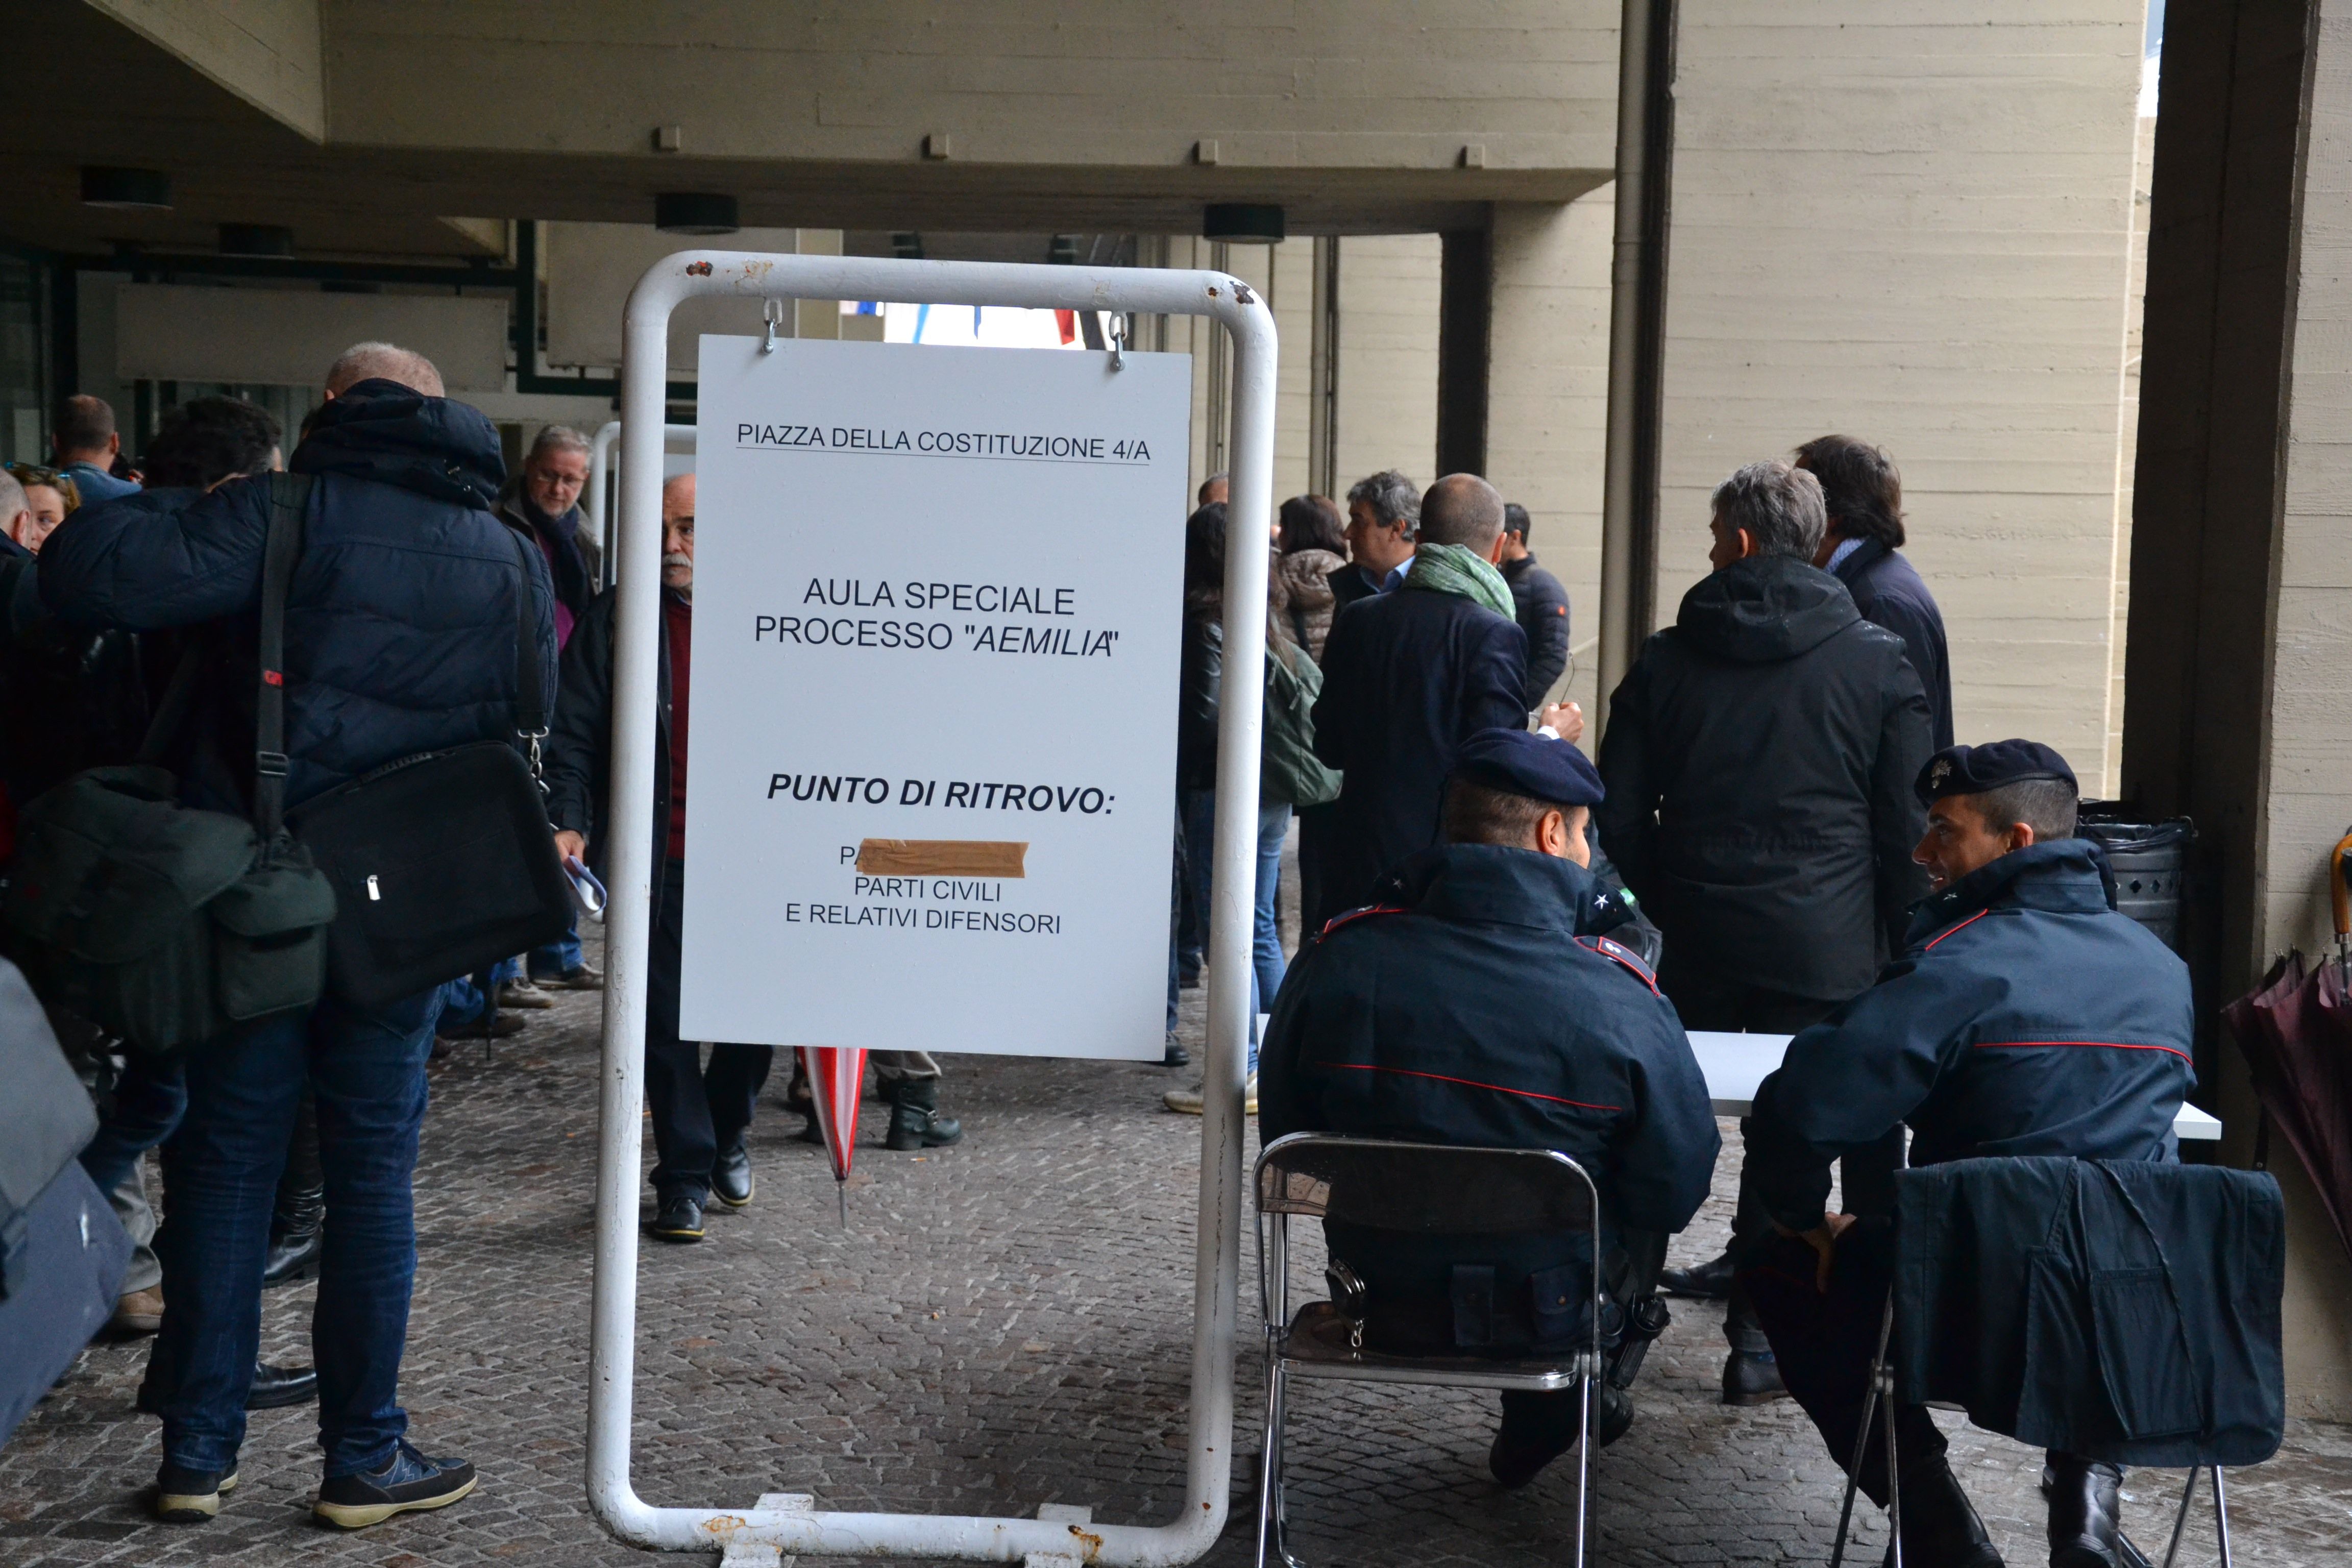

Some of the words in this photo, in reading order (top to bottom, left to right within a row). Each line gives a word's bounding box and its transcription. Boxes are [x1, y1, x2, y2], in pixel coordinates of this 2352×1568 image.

[738, 423, 826, 447] PIAZZA
[831, 427, 912, 451] DELLA
[917, 431, 1105, 459] COSTITUZIONE
[1112, 439, 1152, 461] 4/A
[802, 577, 896, 608] AULA
[904, 581, 1075, 616] SPECIALE
[755, 615, 953, 651] PROCESSO
[964, 624, 1119, 657] "AEMILIA"
[767, 773, 890, 805] PUNTO
[898, 779, 937, 807] DI
[943, 781, 1116, 815] RITROVO:
[854, 876, 924, 899] PARTI
[933, 880, 1001, 902] CIVILI
[786, 902, 801, 923] E
[810, 903, 917, 928] RELATIVI
[925, 909, 1061, 935] DIFENSORI
